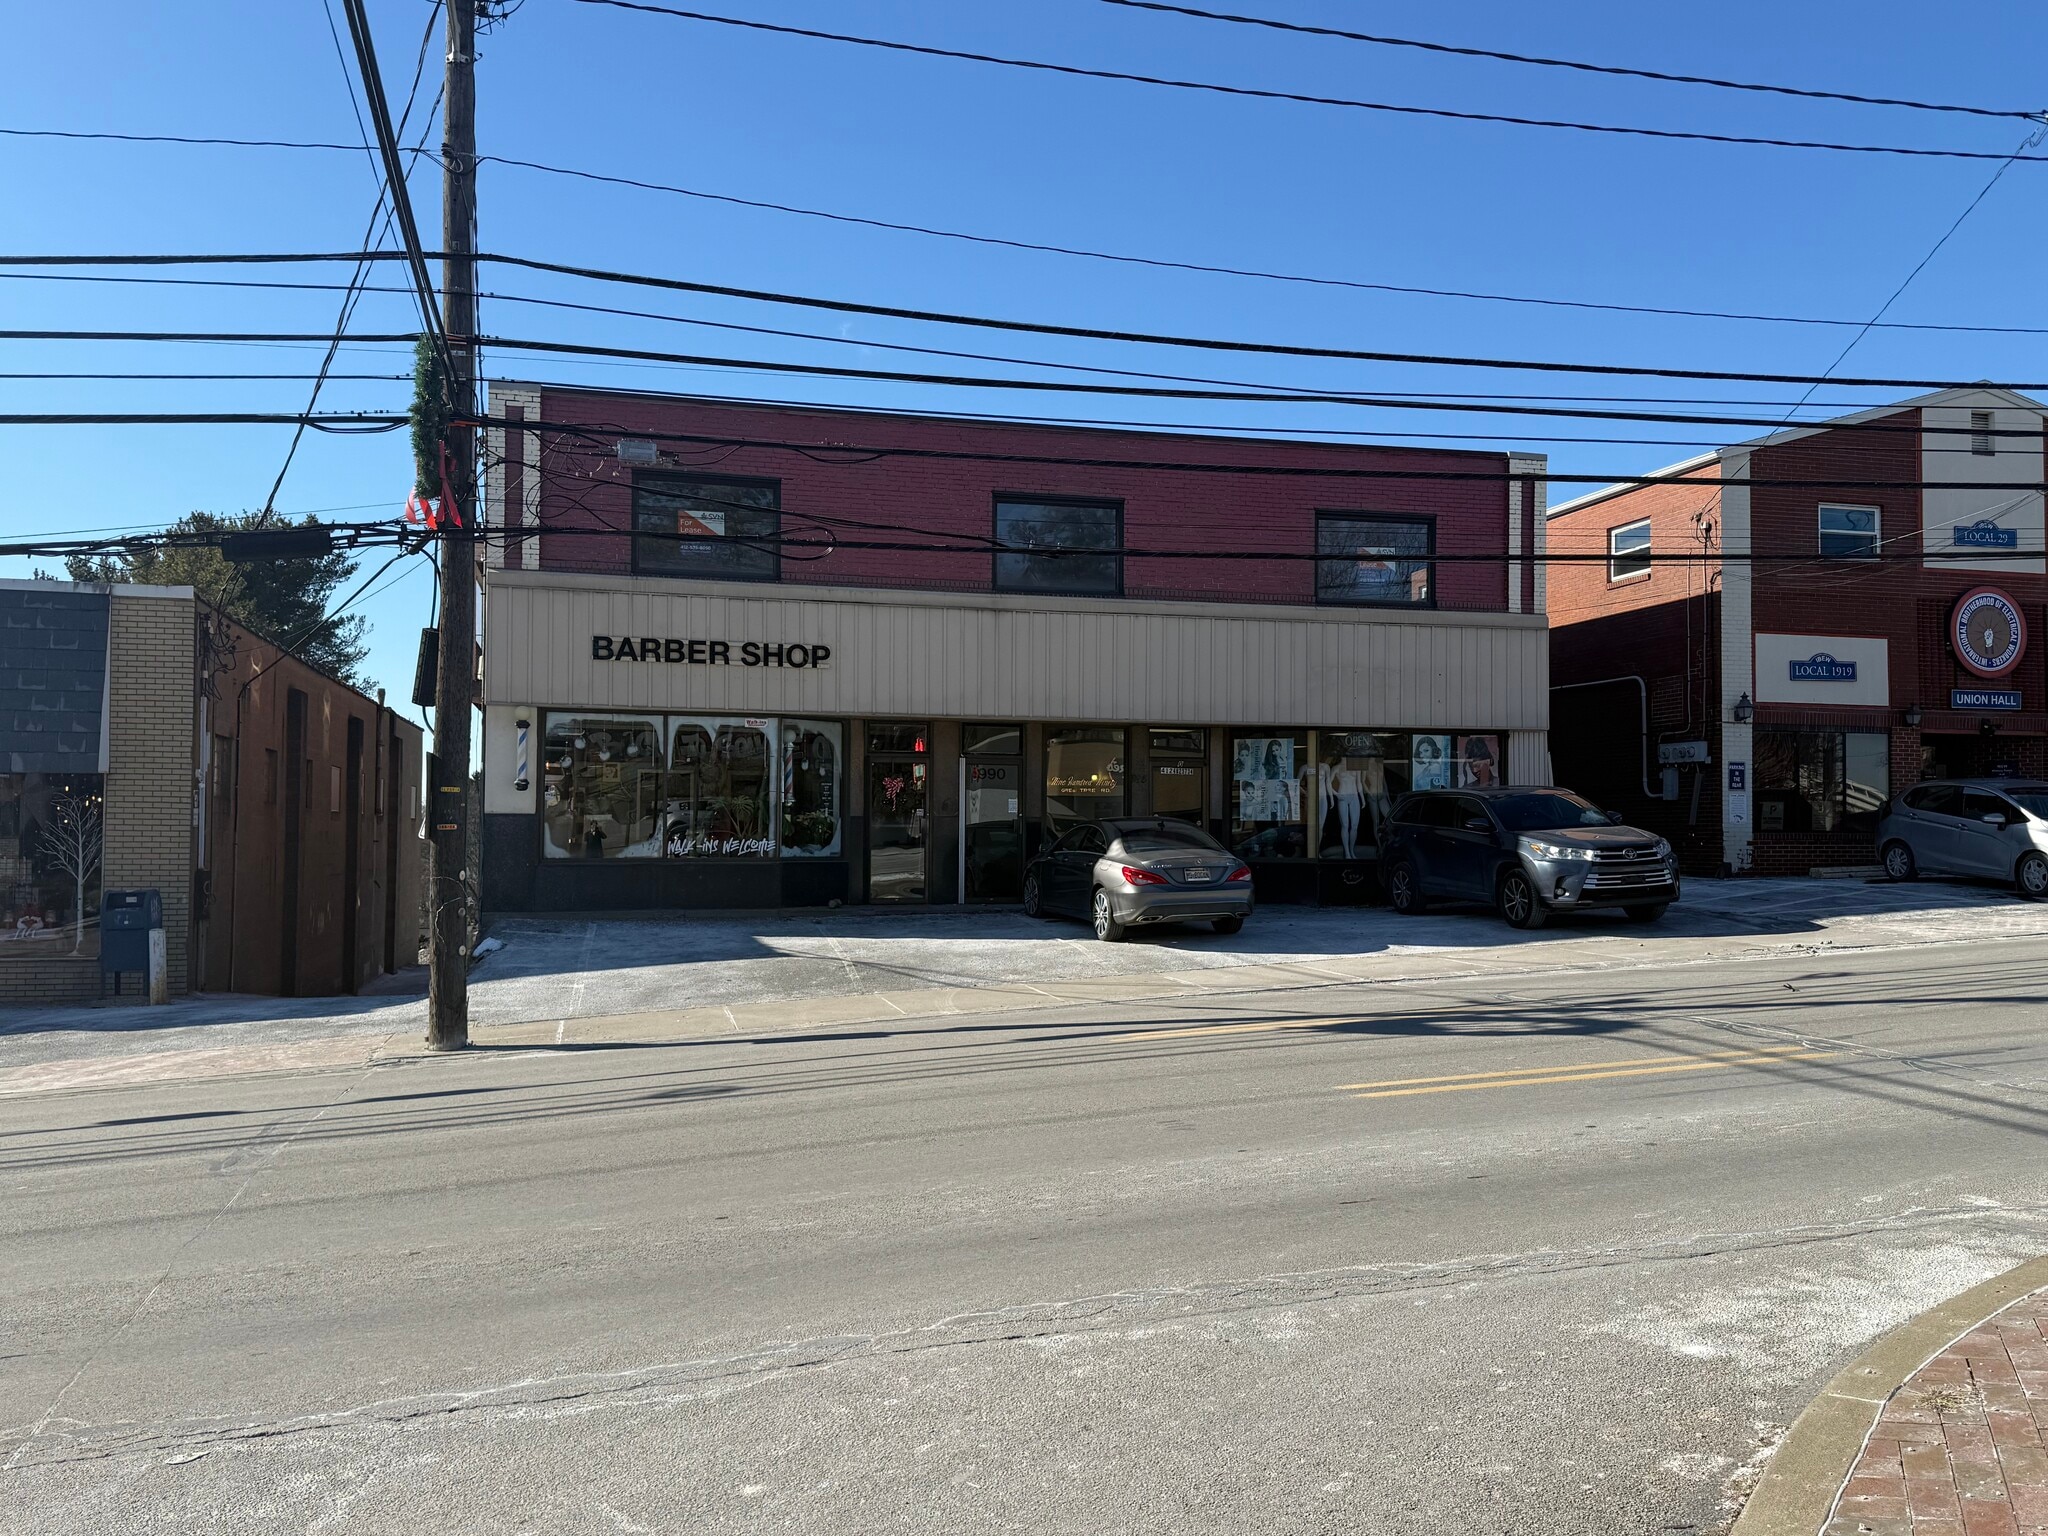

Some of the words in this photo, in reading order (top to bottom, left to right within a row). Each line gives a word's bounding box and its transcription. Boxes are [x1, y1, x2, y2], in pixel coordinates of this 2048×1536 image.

[1964, 531, 1997, 542] LOCAL
[1997, 534, 2008, 543] 29
[1960, 597, 1995, 624] BROTHERHOOD
[1994, 600, 2004, 609] OF
[2001, 605, 2018, 642] ELECTRICAL
[592, 635, 730, 664] BARBER
[741, 642, 831, 668] SHOP
[1959, 625, 1988, 667] INTERNATIONAL
[1815, 655, 1832, 663] IBEW
[1992, 643, 2016, 667] WORKERS
[1795, 665, 1829, 676] LOCAL
[1832, 666, 1853, 677] 1919
[1956, 694, 1988, 705] UNION
[1991, 695, 2017, 706] HALL
[1345, 735, 1369, 747] OPEN
[722, 837, 776, 858] WELCOME
